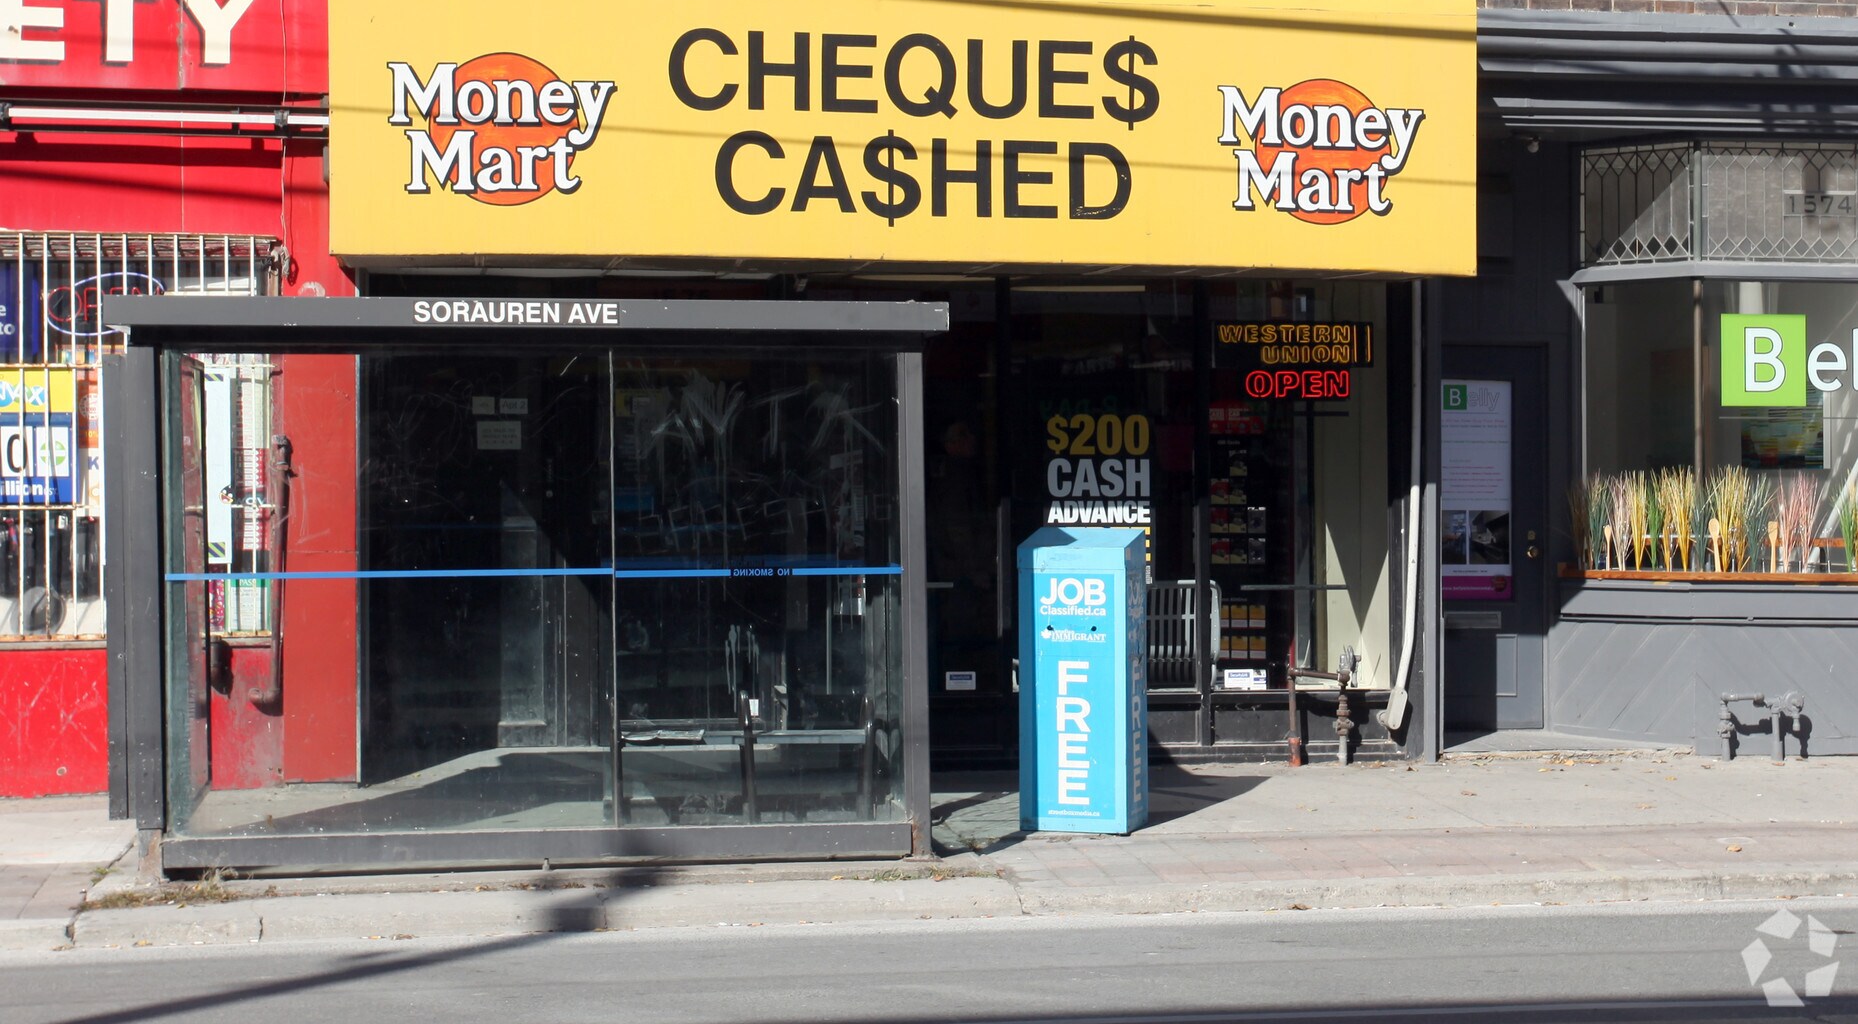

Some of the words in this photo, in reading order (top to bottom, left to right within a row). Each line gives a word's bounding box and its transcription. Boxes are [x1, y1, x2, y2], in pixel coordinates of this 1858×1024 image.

[668, 28, 1161, 131] CHEQUE$
[387, 62, 618, 150] Money
[1217, 84, 1426, 174] Money
[404, 127, 582, 194] Mart
[715, 130, 1133, 228] CA$HED
[1232, 148, 1394, 217] Mart
[1788, 195, 1853, 214] 1574
[413, 301, 561, 324] SORAUREN
[567, 303, 619, 325] AVE
[1218, 323, 1352, 345] WESTERN
[1261, 344, 1351, 365] UNION
[1244, 369, 1351, 399] OPEN
[1449, 387, 1501, 412] Belly
[1046, 414, 1151, 457] $200
[1047, 457, 1151, 498] CASH
[1047, 500, 1151, 524] ADVANCE
[1040, 577, 1107, 606] JOB
[1040, 604, 1107, 616] Classified.ca
[1052, 631, 1106, 642] IMMIGRANT
[1055, 659, 1092, 806] FREE
